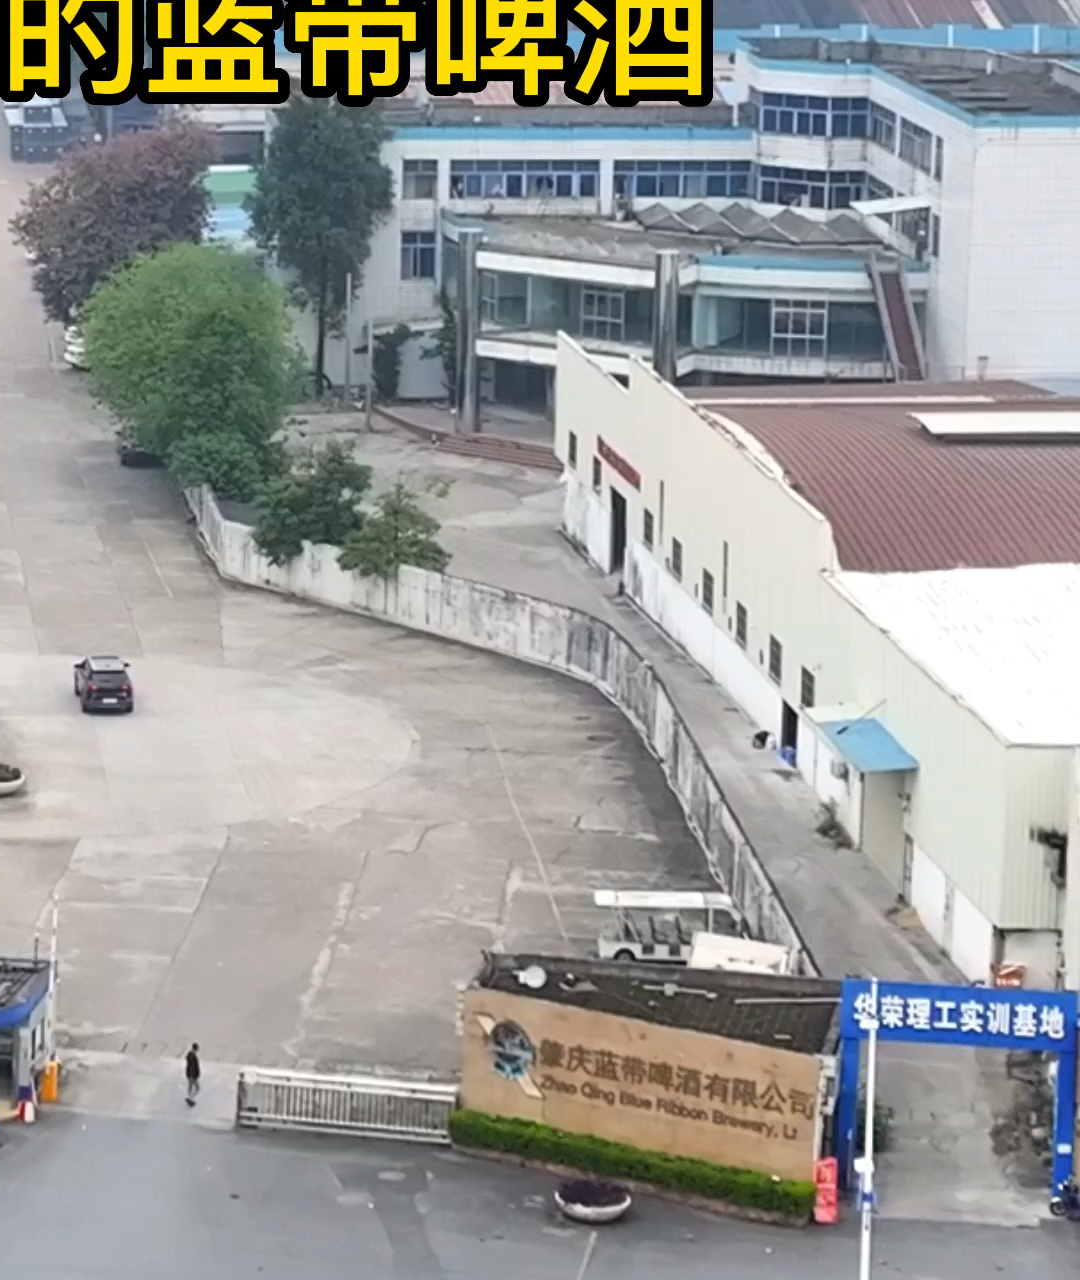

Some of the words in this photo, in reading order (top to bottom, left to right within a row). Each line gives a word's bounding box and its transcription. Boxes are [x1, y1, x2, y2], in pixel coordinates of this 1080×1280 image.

[539, 1039, 815, 1120] 肇庆蓝带啤酒有限公司
[540, 1074, 578, 1095] Zhao
[580, 1081, 615, 1105] Qing
[619, 1090, 653, 1111] Blue
[655, 1097, 708, 1122] Ribbon
